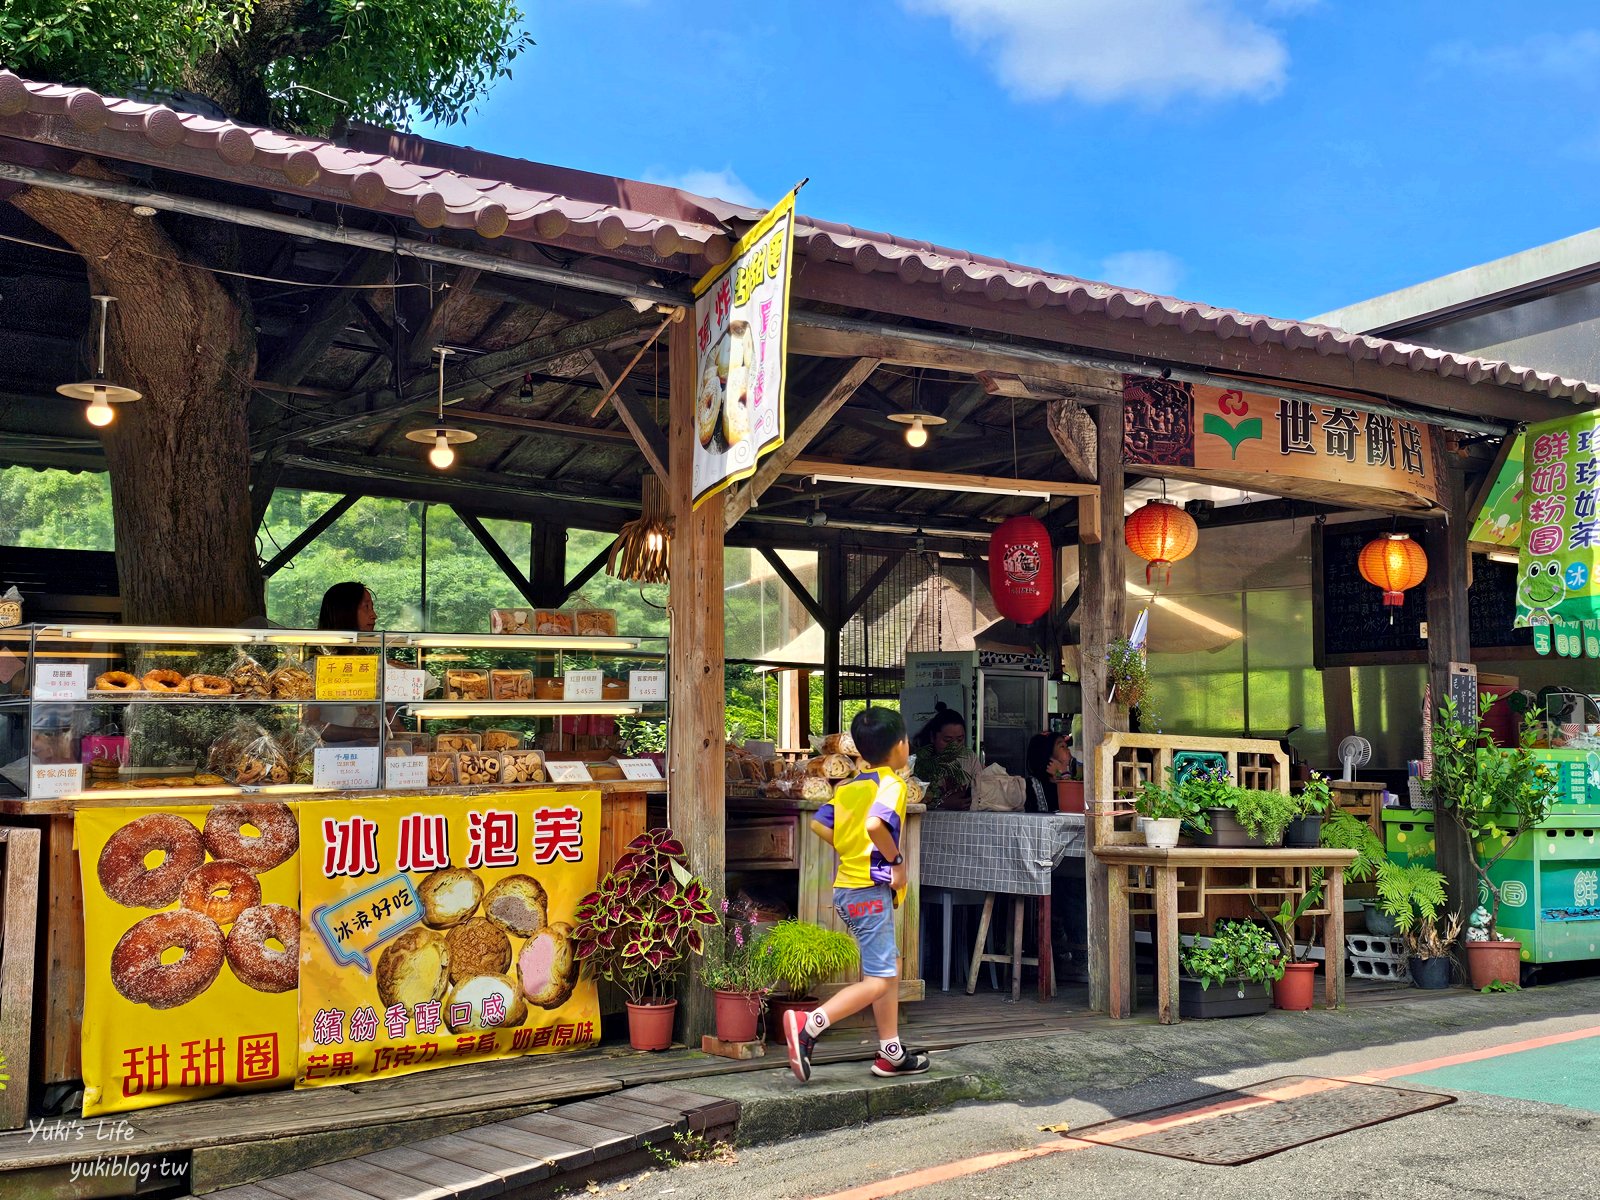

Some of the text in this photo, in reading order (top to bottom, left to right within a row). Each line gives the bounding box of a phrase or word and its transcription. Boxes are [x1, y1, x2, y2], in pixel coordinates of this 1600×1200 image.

[1275, 399, 1425, 477] 世奇餅店
[1529, 431, 1570, 556] 鮮奶粉圓
[1567, 565, 1586, 586] 冰
[327, 662, 370, 673] 千層酥
[36, 768, 78, 779] 客家肉餅
[322, 807, 584, 877] 冰心泡芙
[847, 899, 884, 918] BOYS
[1574, 871, 1599, 907] 鮮
[333, 888, 413, 943] 冰涼好吃
[313, 993, 506, 1045] 繽紛香醇口感
[510, 1021, 593, 1051] 奶香原味
[122, 1032, 280, 1098] 甜甜圈
